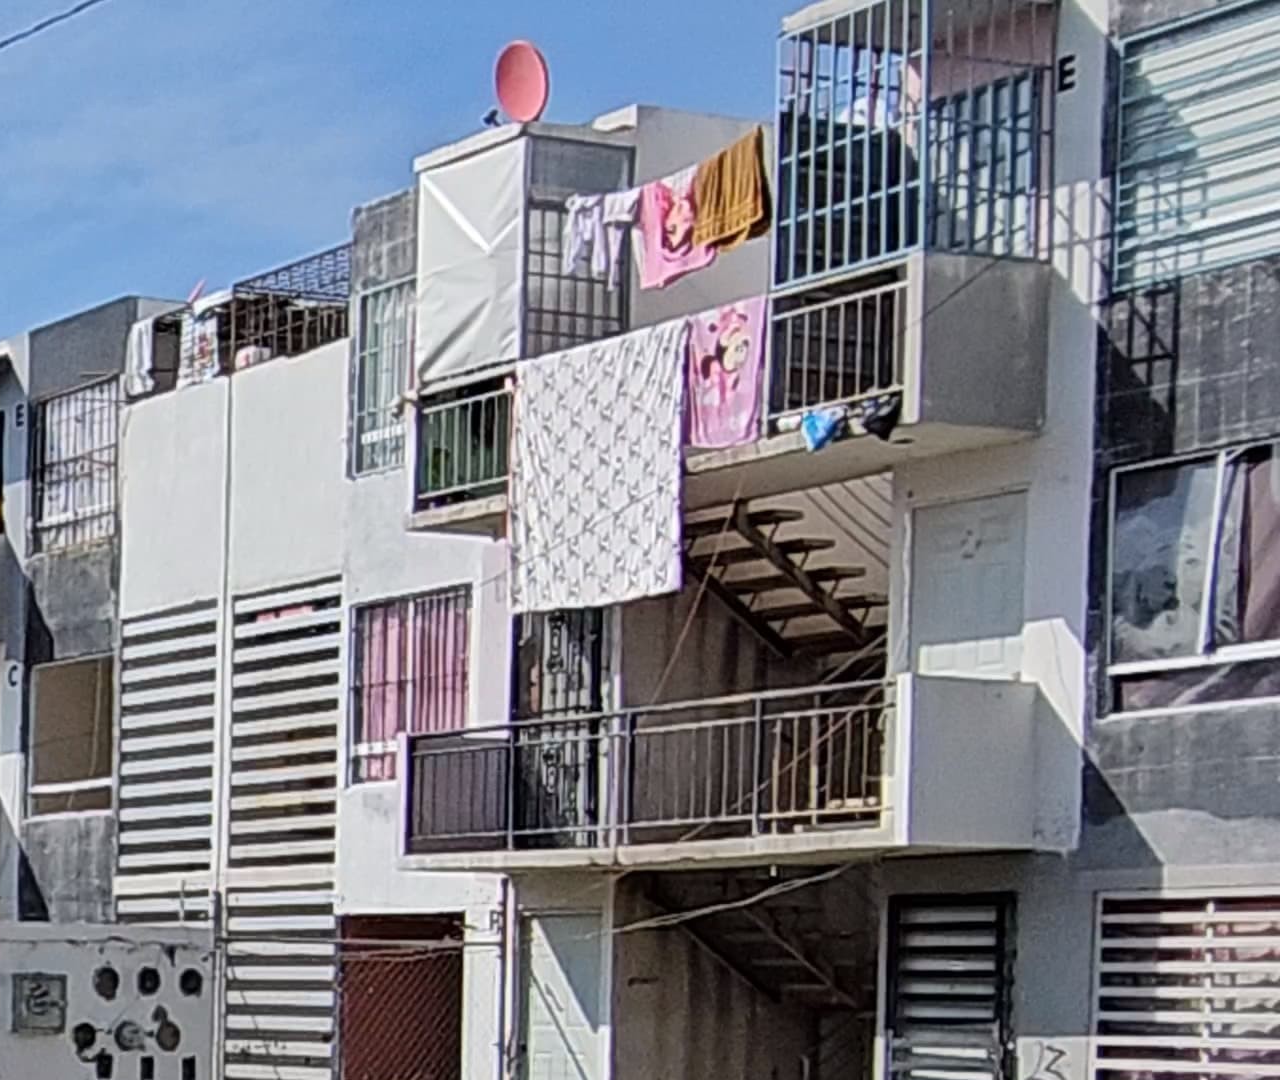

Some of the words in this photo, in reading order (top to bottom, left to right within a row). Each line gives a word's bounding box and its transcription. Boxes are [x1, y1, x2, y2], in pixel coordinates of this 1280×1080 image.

[1057, 54, 1076, 93] E
[16, 404, 25, 427] E
[7, 664, 19, 688] C
